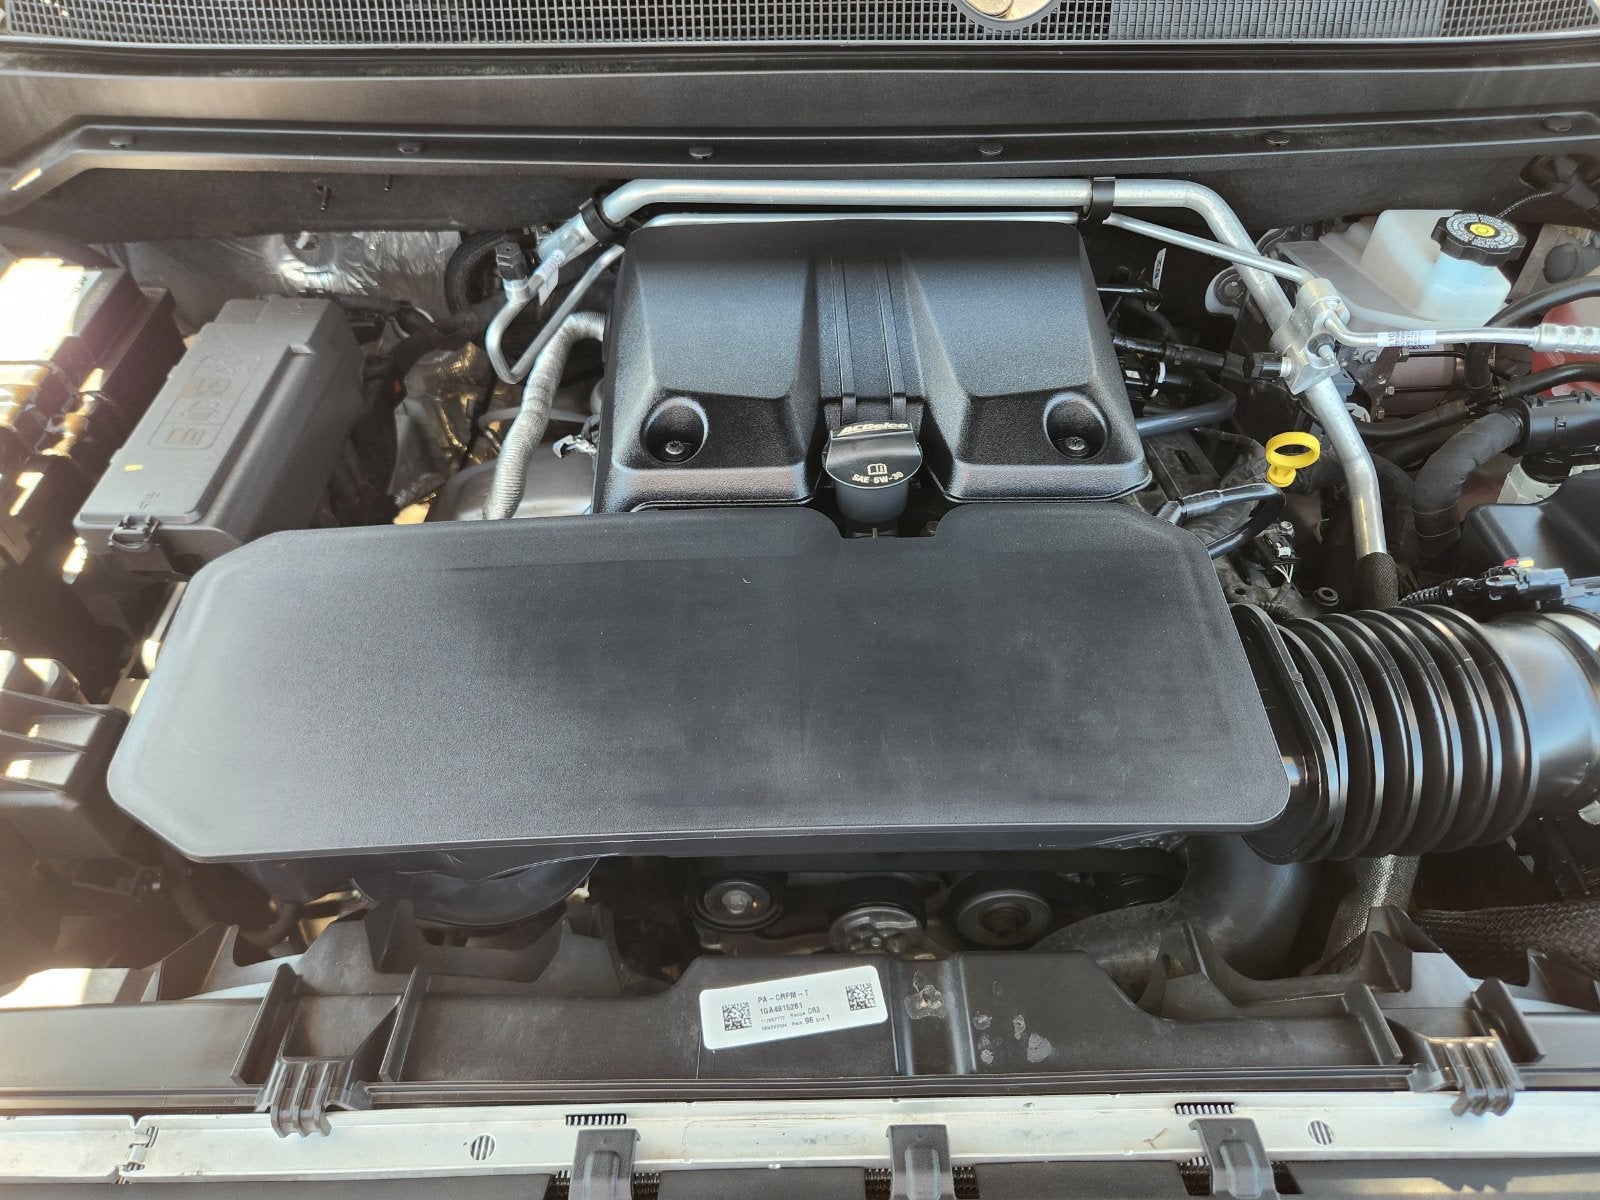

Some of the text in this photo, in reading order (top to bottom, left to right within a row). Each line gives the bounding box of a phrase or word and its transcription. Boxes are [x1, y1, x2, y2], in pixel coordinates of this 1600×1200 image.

[837, 422, 909, 437] ACDelco
[852, 471, 904, 484] SAE 5W-30
[804, 1016, 814, 1025] 96
